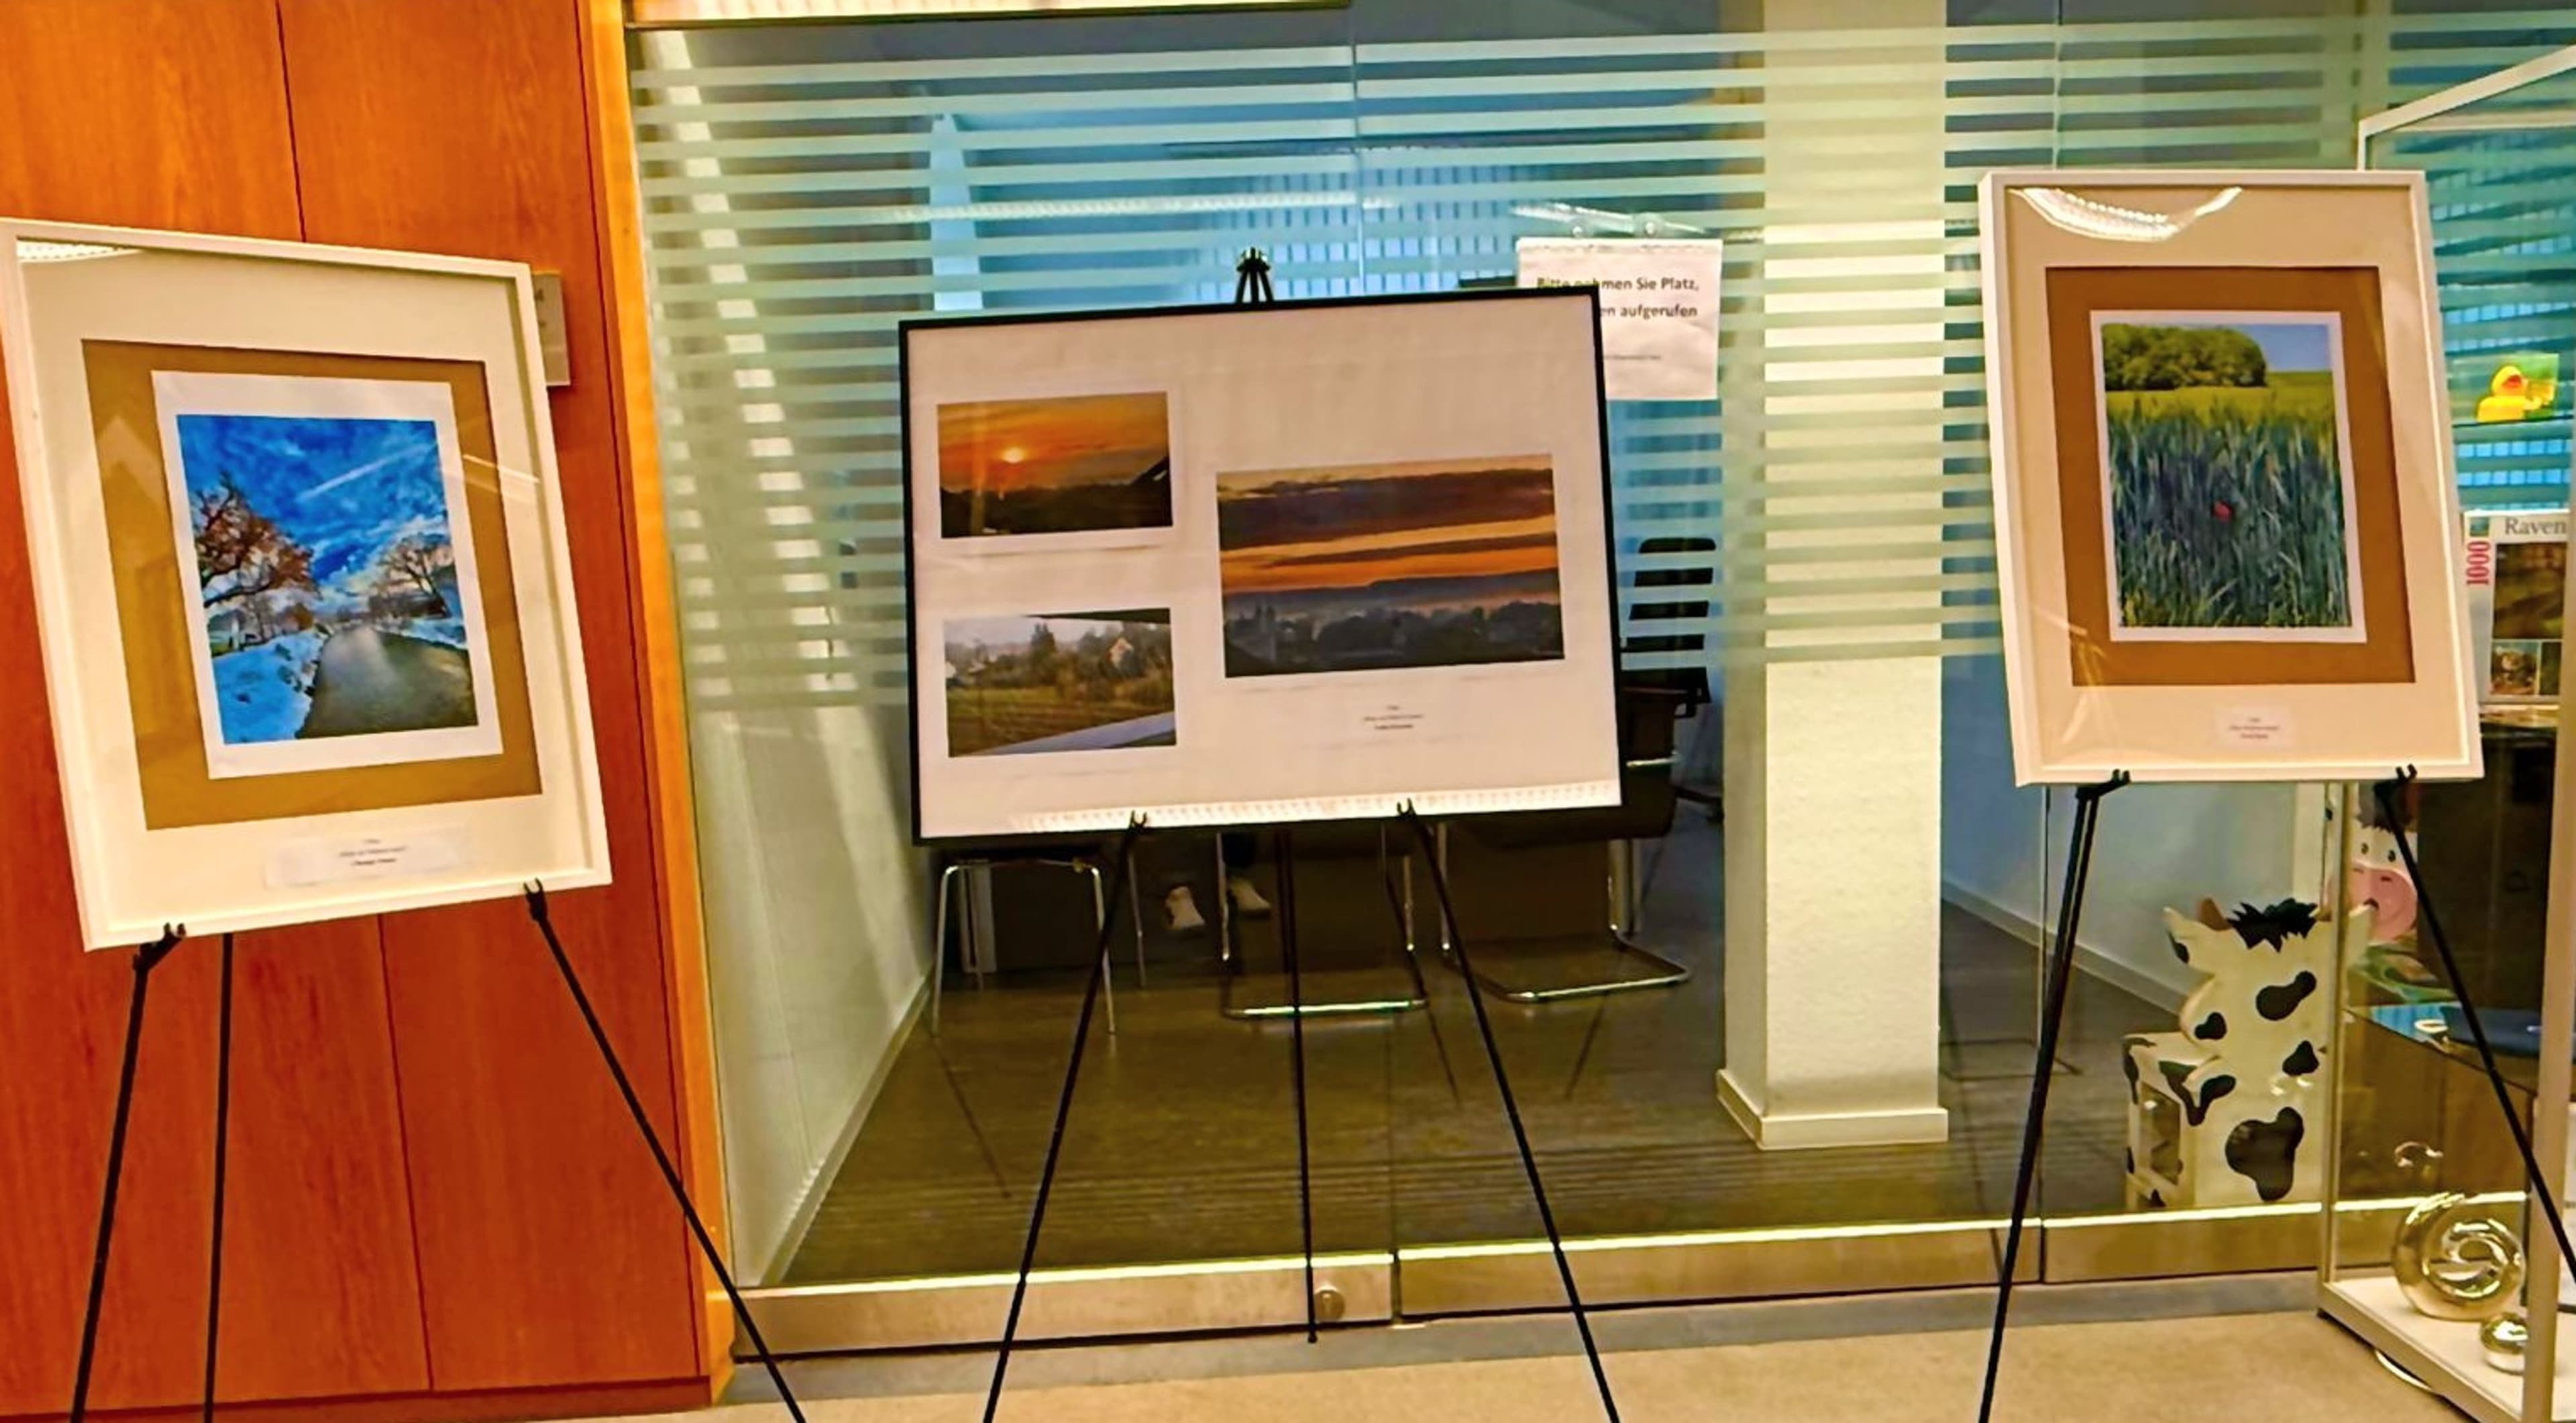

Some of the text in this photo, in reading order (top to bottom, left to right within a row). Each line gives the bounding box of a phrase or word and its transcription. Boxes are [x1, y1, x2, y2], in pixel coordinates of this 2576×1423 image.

[1636, 277, 1656, 290] Sie
[1661, 277, 1699, 291] Platz,
[1620, 304, 1698, 320] aufgerufen
[2465, 541, 2491, 586] 1000
